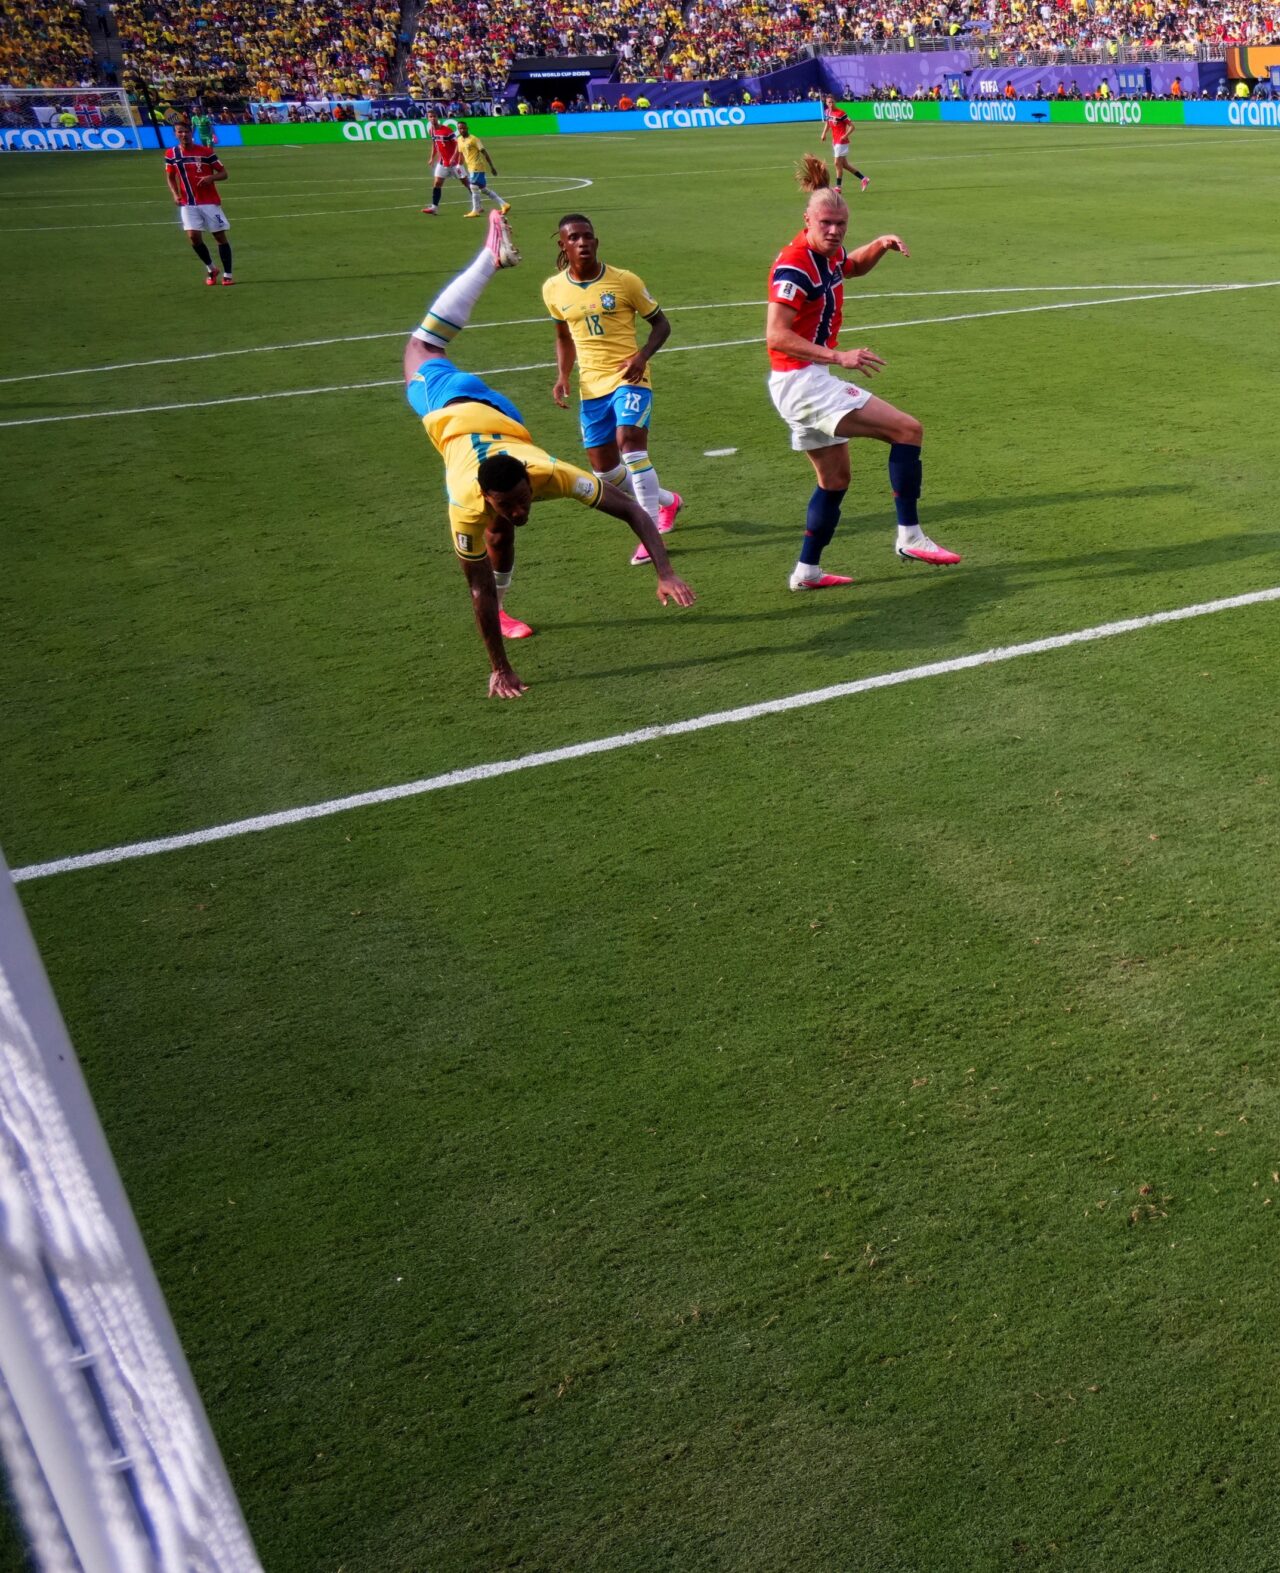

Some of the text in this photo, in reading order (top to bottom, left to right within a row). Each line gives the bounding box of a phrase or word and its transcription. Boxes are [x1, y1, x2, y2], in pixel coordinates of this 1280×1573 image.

[980, 80, 999, 93] FIFA
[643, 107, 746, 129] aramco
[873, 102, 914, 120] aramco
[969, 102, 1016, 121] aramco
[1084, 102, 1141, 124] aramco
[0, 127, 126, 150] ramco
[585, 314, 605, 336] 18
[624, 392, 642, 412] 18
